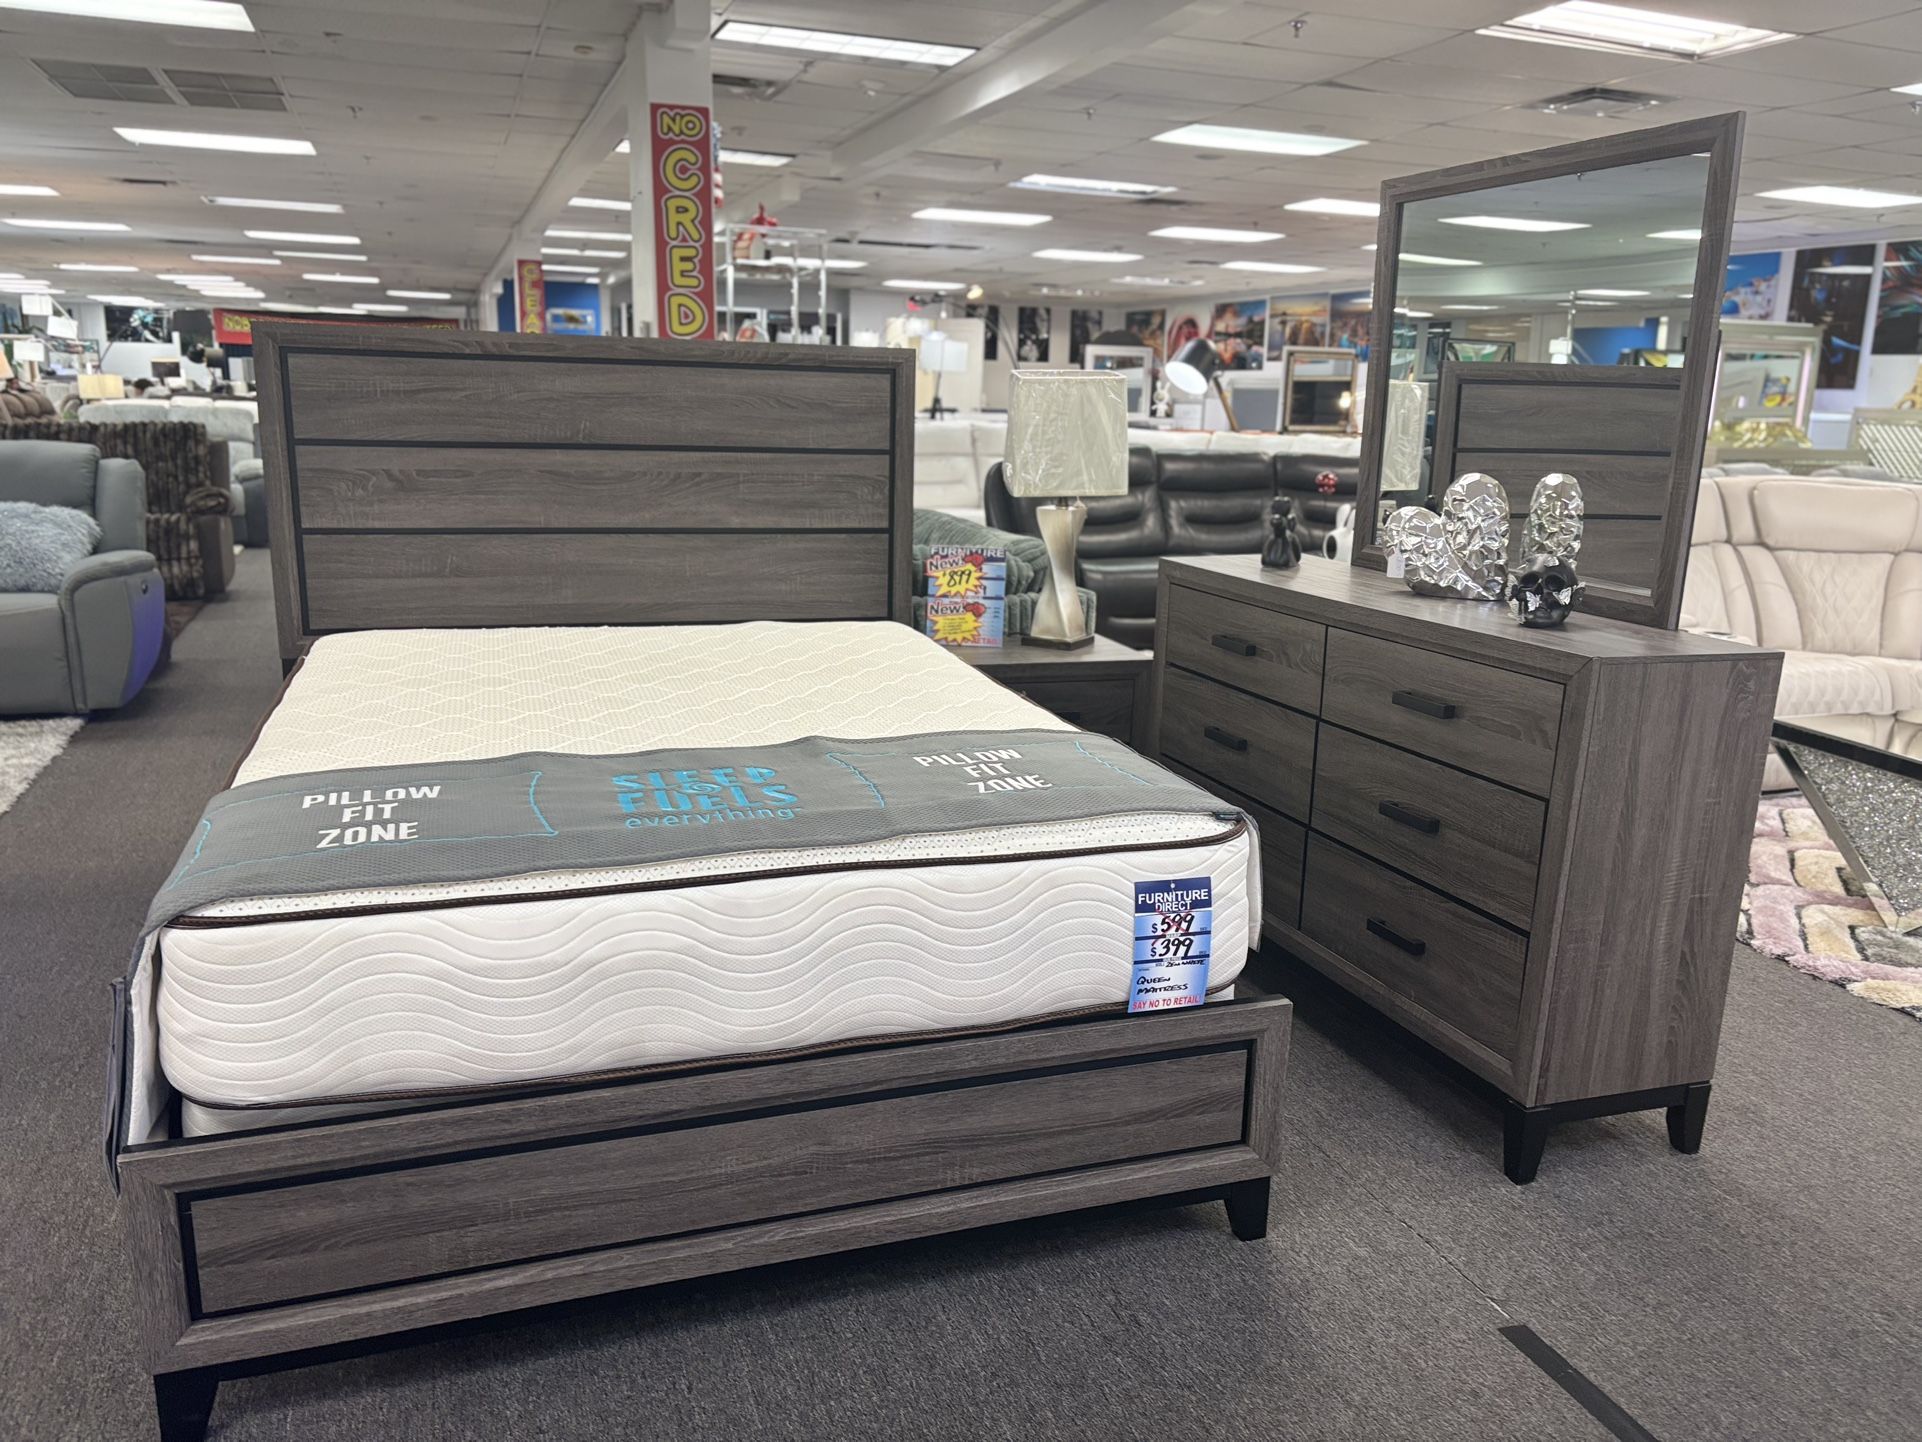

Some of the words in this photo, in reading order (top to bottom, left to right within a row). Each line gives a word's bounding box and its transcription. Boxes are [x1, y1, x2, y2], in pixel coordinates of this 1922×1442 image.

[660, 109, 703, 137] NO
[523, 264, 541, 334] CLEA
[929, 557, 965, 571] New!
[942, 569, 972, 588] $899
[930, 604, 965, 614] New!
[913, 749, 1023, 767] PILLOW
[611, 767, 777, 791] SLEEP
[963, 762, 1011, 778] FIT
[967, 774, 1053, 794] ZONE
[302, 785, 441, 809] PILLOW
[617, 784, 799, 814] FUELS
[341, 802, 399, 823] FIT
[624, 806, 797, 829] everything
[316, 821, 419, 848] ZONE
[1138, 889, 1209, 904] FURNITURE
[1155, 900, 1192, 912] DIRECT
[1137, 975, 1171, 986] QUEEN
[1132, 1000, 1148, 1010] SAY
[1148, 999, 1160, 1008] NO
[1161, 997, 1172, 1007] TO
